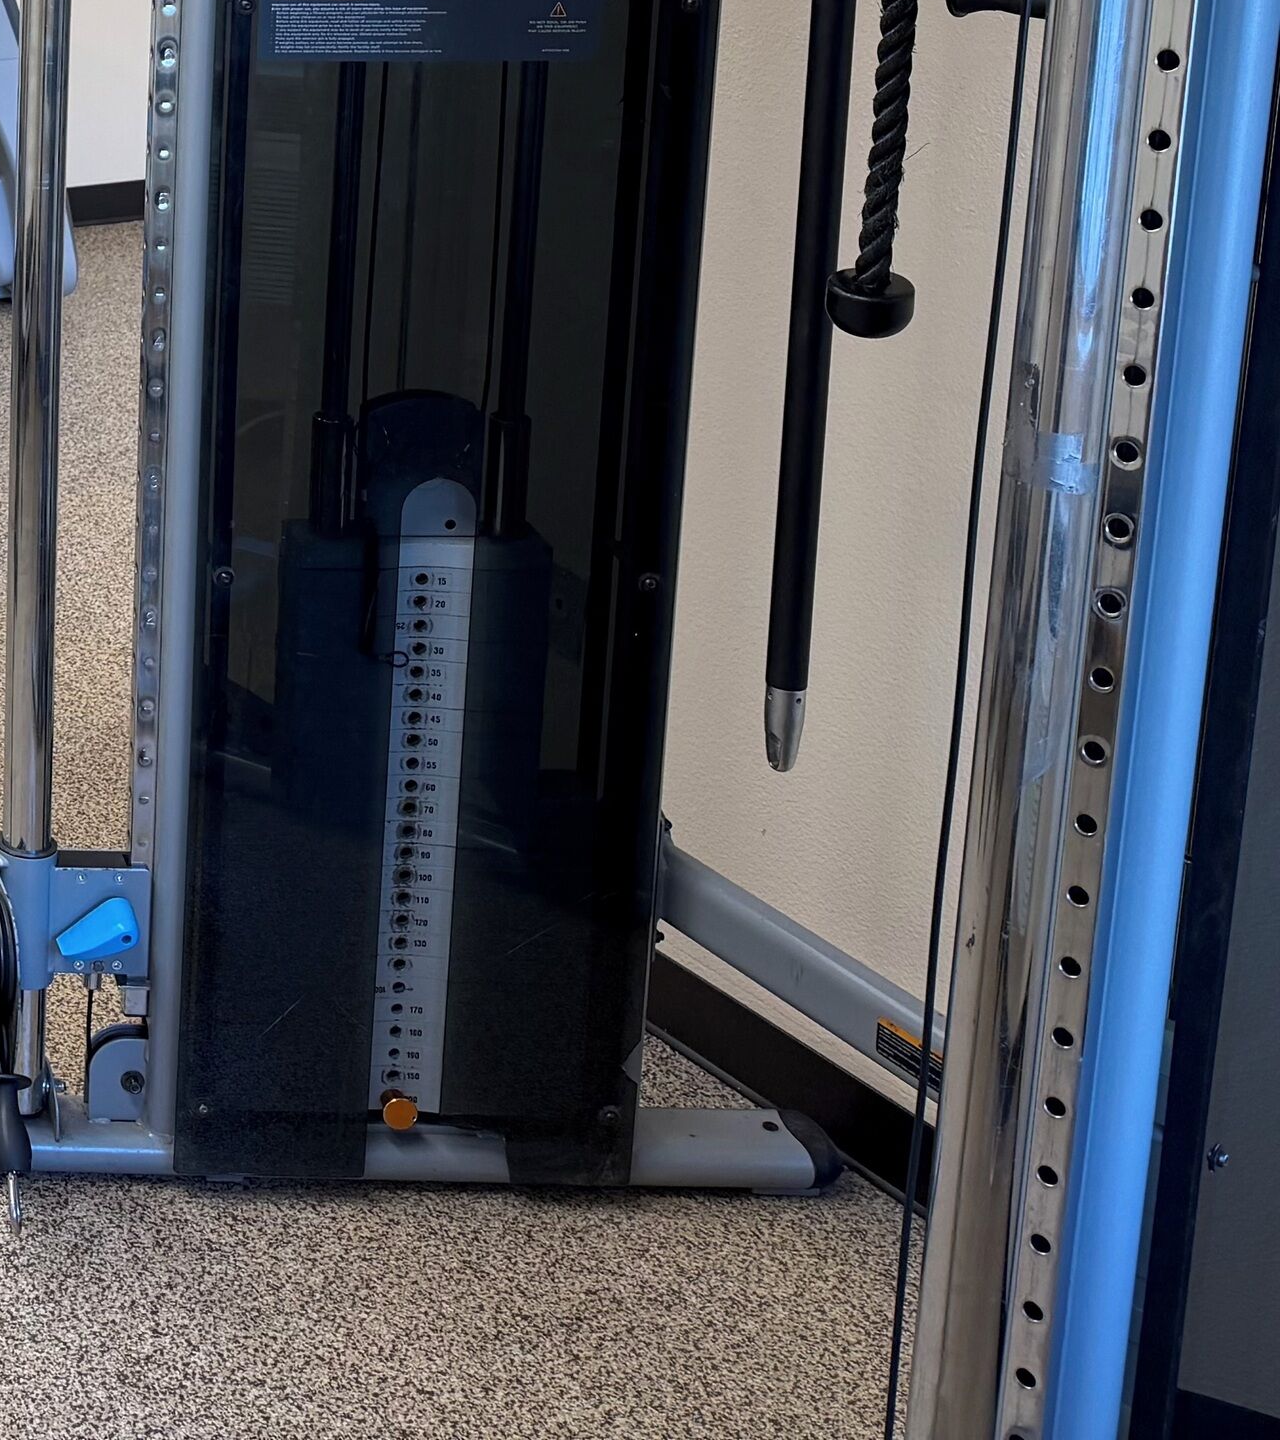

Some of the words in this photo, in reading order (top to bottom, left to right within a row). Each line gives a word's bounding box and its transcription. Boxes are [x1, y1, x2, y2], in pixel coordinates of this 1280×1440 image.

[438, 577, 447, 586] 15
[435, 600, 446, 608] 20
[433, 647, 444, 655] 30
[430, 669, 441, 677] 35
[431, 693, 442, 701] 40
[430, 715, 441, 724] 45
[427, 738, 438, 746] 50
[426, 761, 437, 769] 55
[424, 805, 434, 814] 70
[418, 873, 432, 882] 100
[415, 896, 429, 905] 110
[415, 919, 428, 927] 120
[413, 940, 427, 948] 130
[410, 1006, 423, 1014] 170
[407, 1072, 420, 1081] 150
